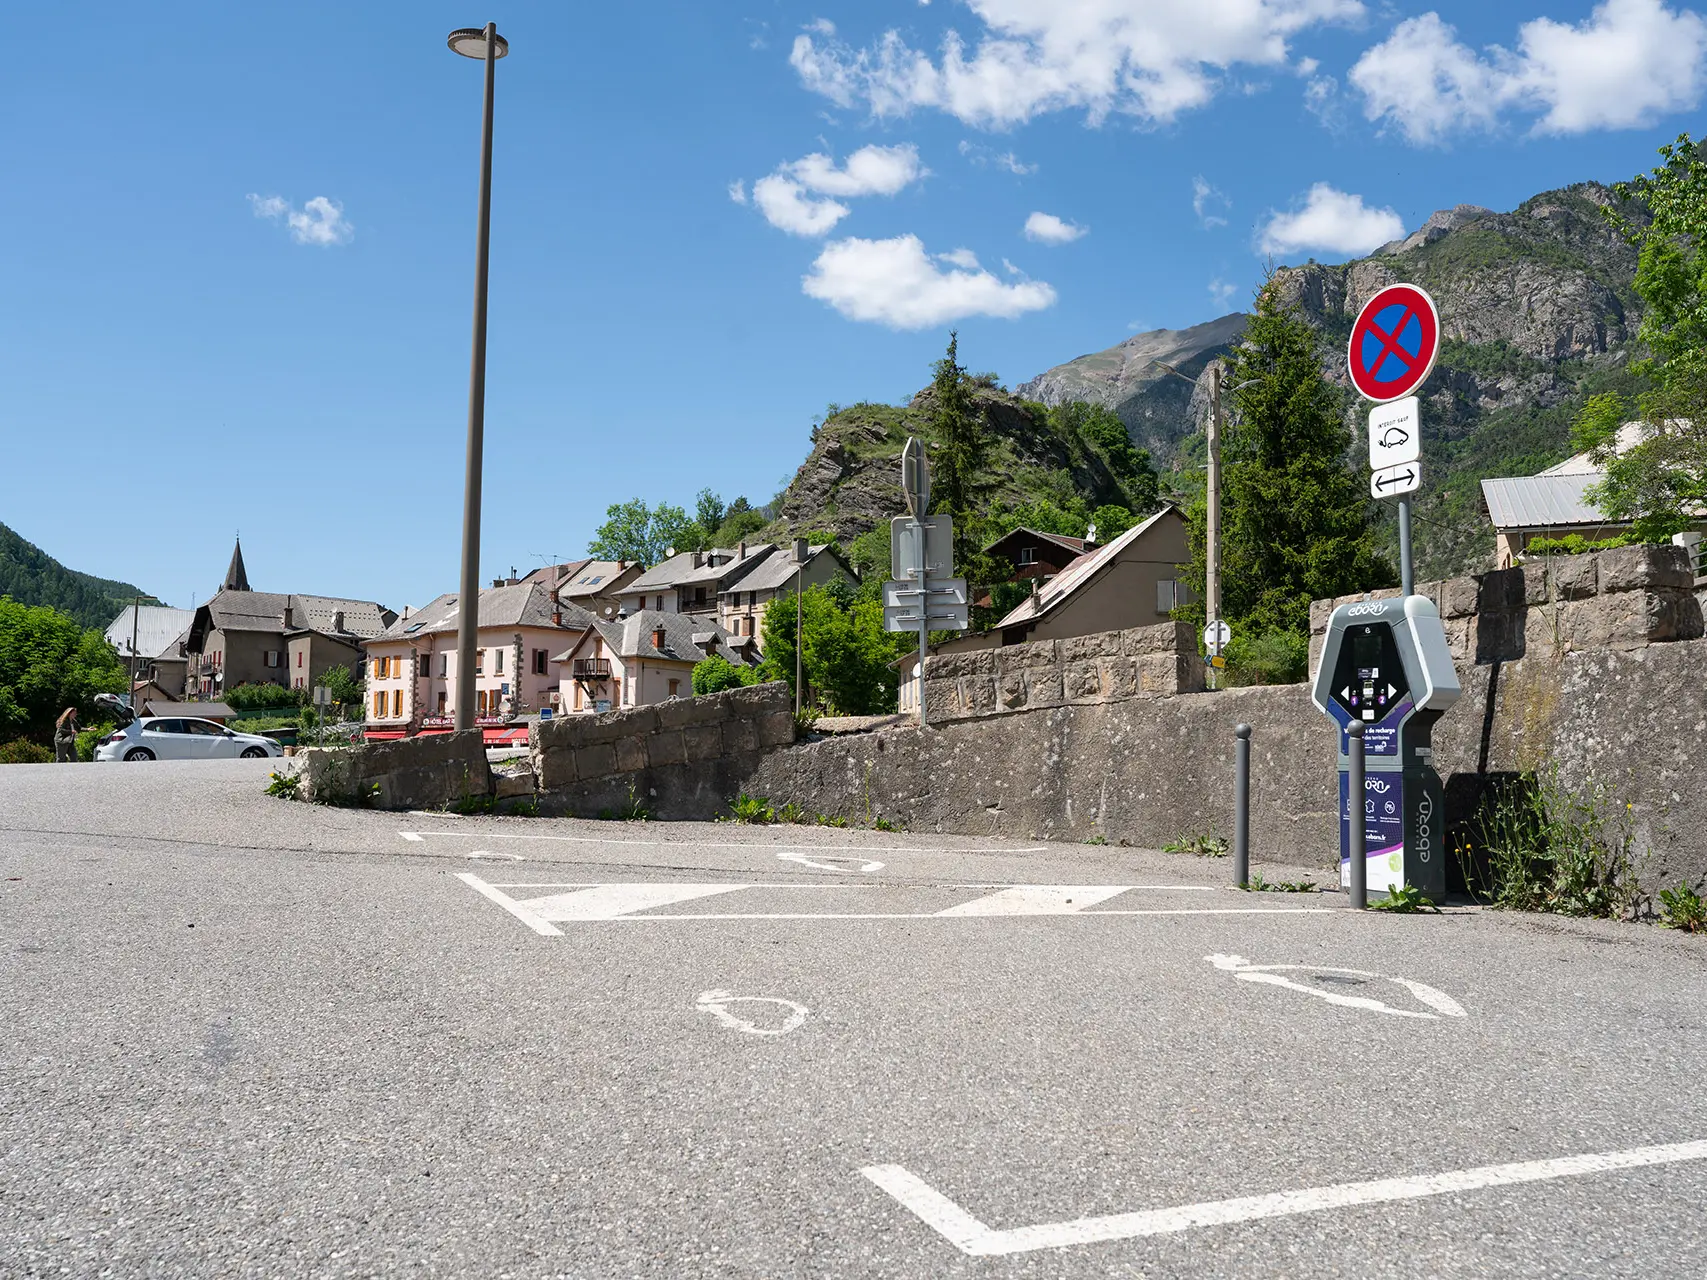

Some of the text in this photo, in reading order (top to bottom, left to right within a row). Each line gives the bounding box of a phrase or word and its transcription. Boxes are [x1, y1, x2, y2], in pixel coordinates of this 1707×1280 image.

[1348, 604, 1389, 616] eborn
[1365, 780, 1391, 794] orn
[1415, 789, 1433, 863] eborn
